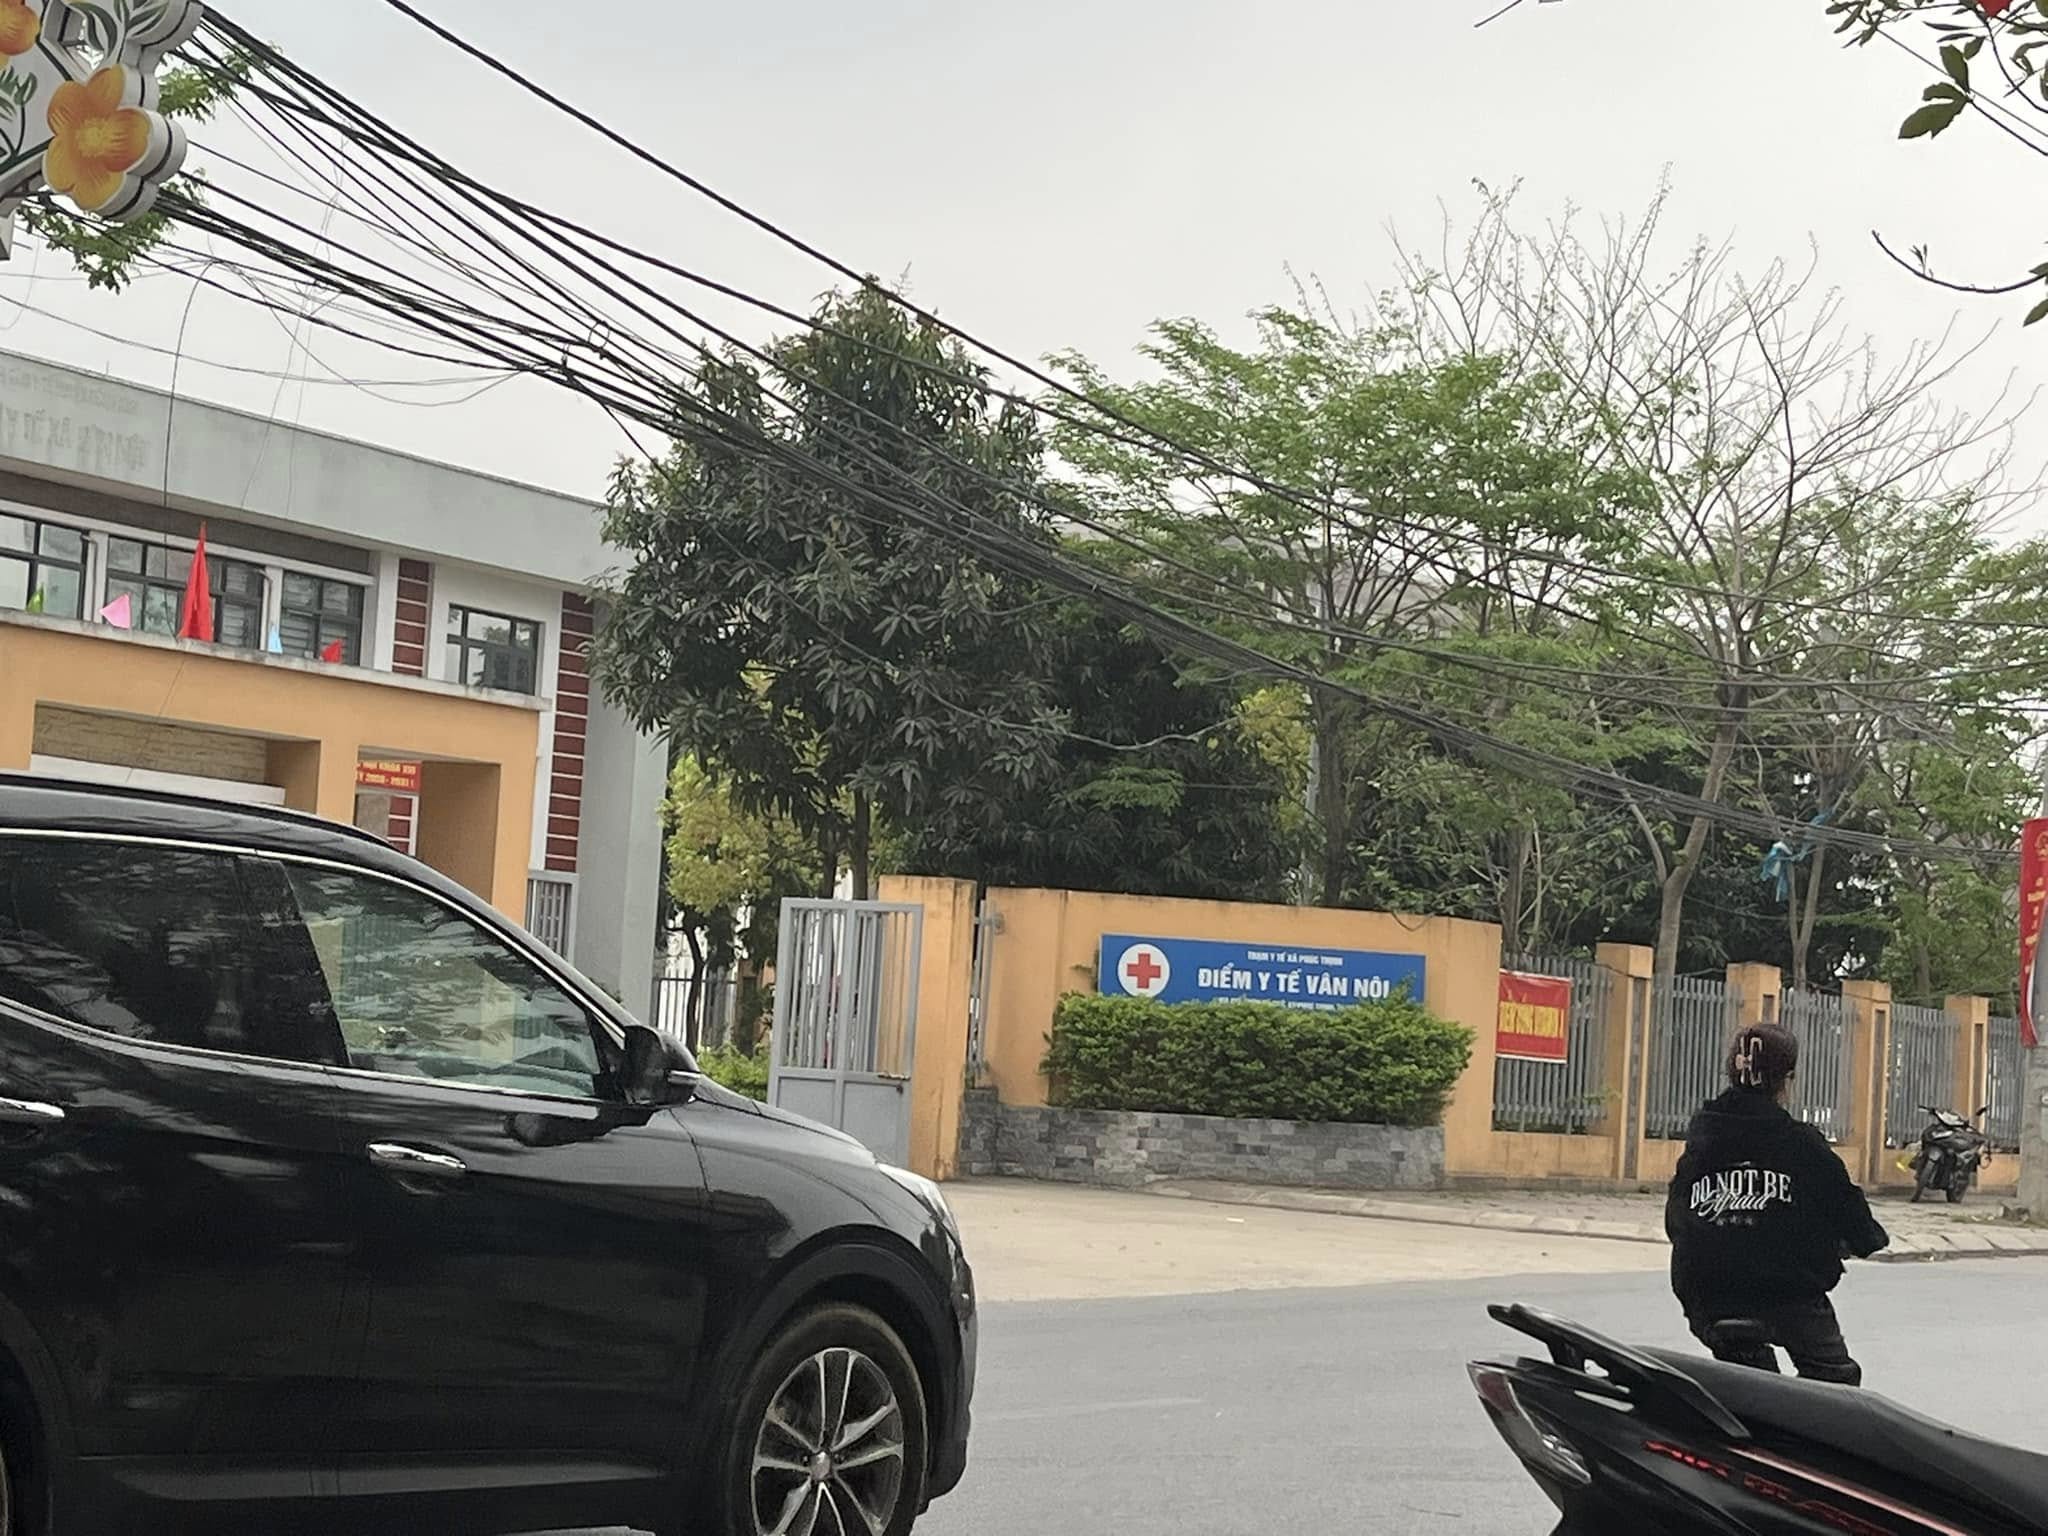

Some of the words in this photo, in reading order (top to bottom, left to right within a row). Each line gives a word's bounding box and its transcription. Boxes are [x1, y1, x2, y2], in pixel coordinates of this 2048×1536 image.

[1270, 953, 1276, 961] Y
[1198, 962, 1252, 990] ĐIỂM
[1258, 972, 1271, 991] Y
[1276, 967, 1303, 993] TẾ
[1306, 972, 1348, 996] VÂN
[1690, 1175, 1710, 1209] DO
[1716, 1169, 1758, 1198] NOT
[1763, 1169, 1792, 1203] BE
[1697, 1189, 1775, 1222] Afraid
